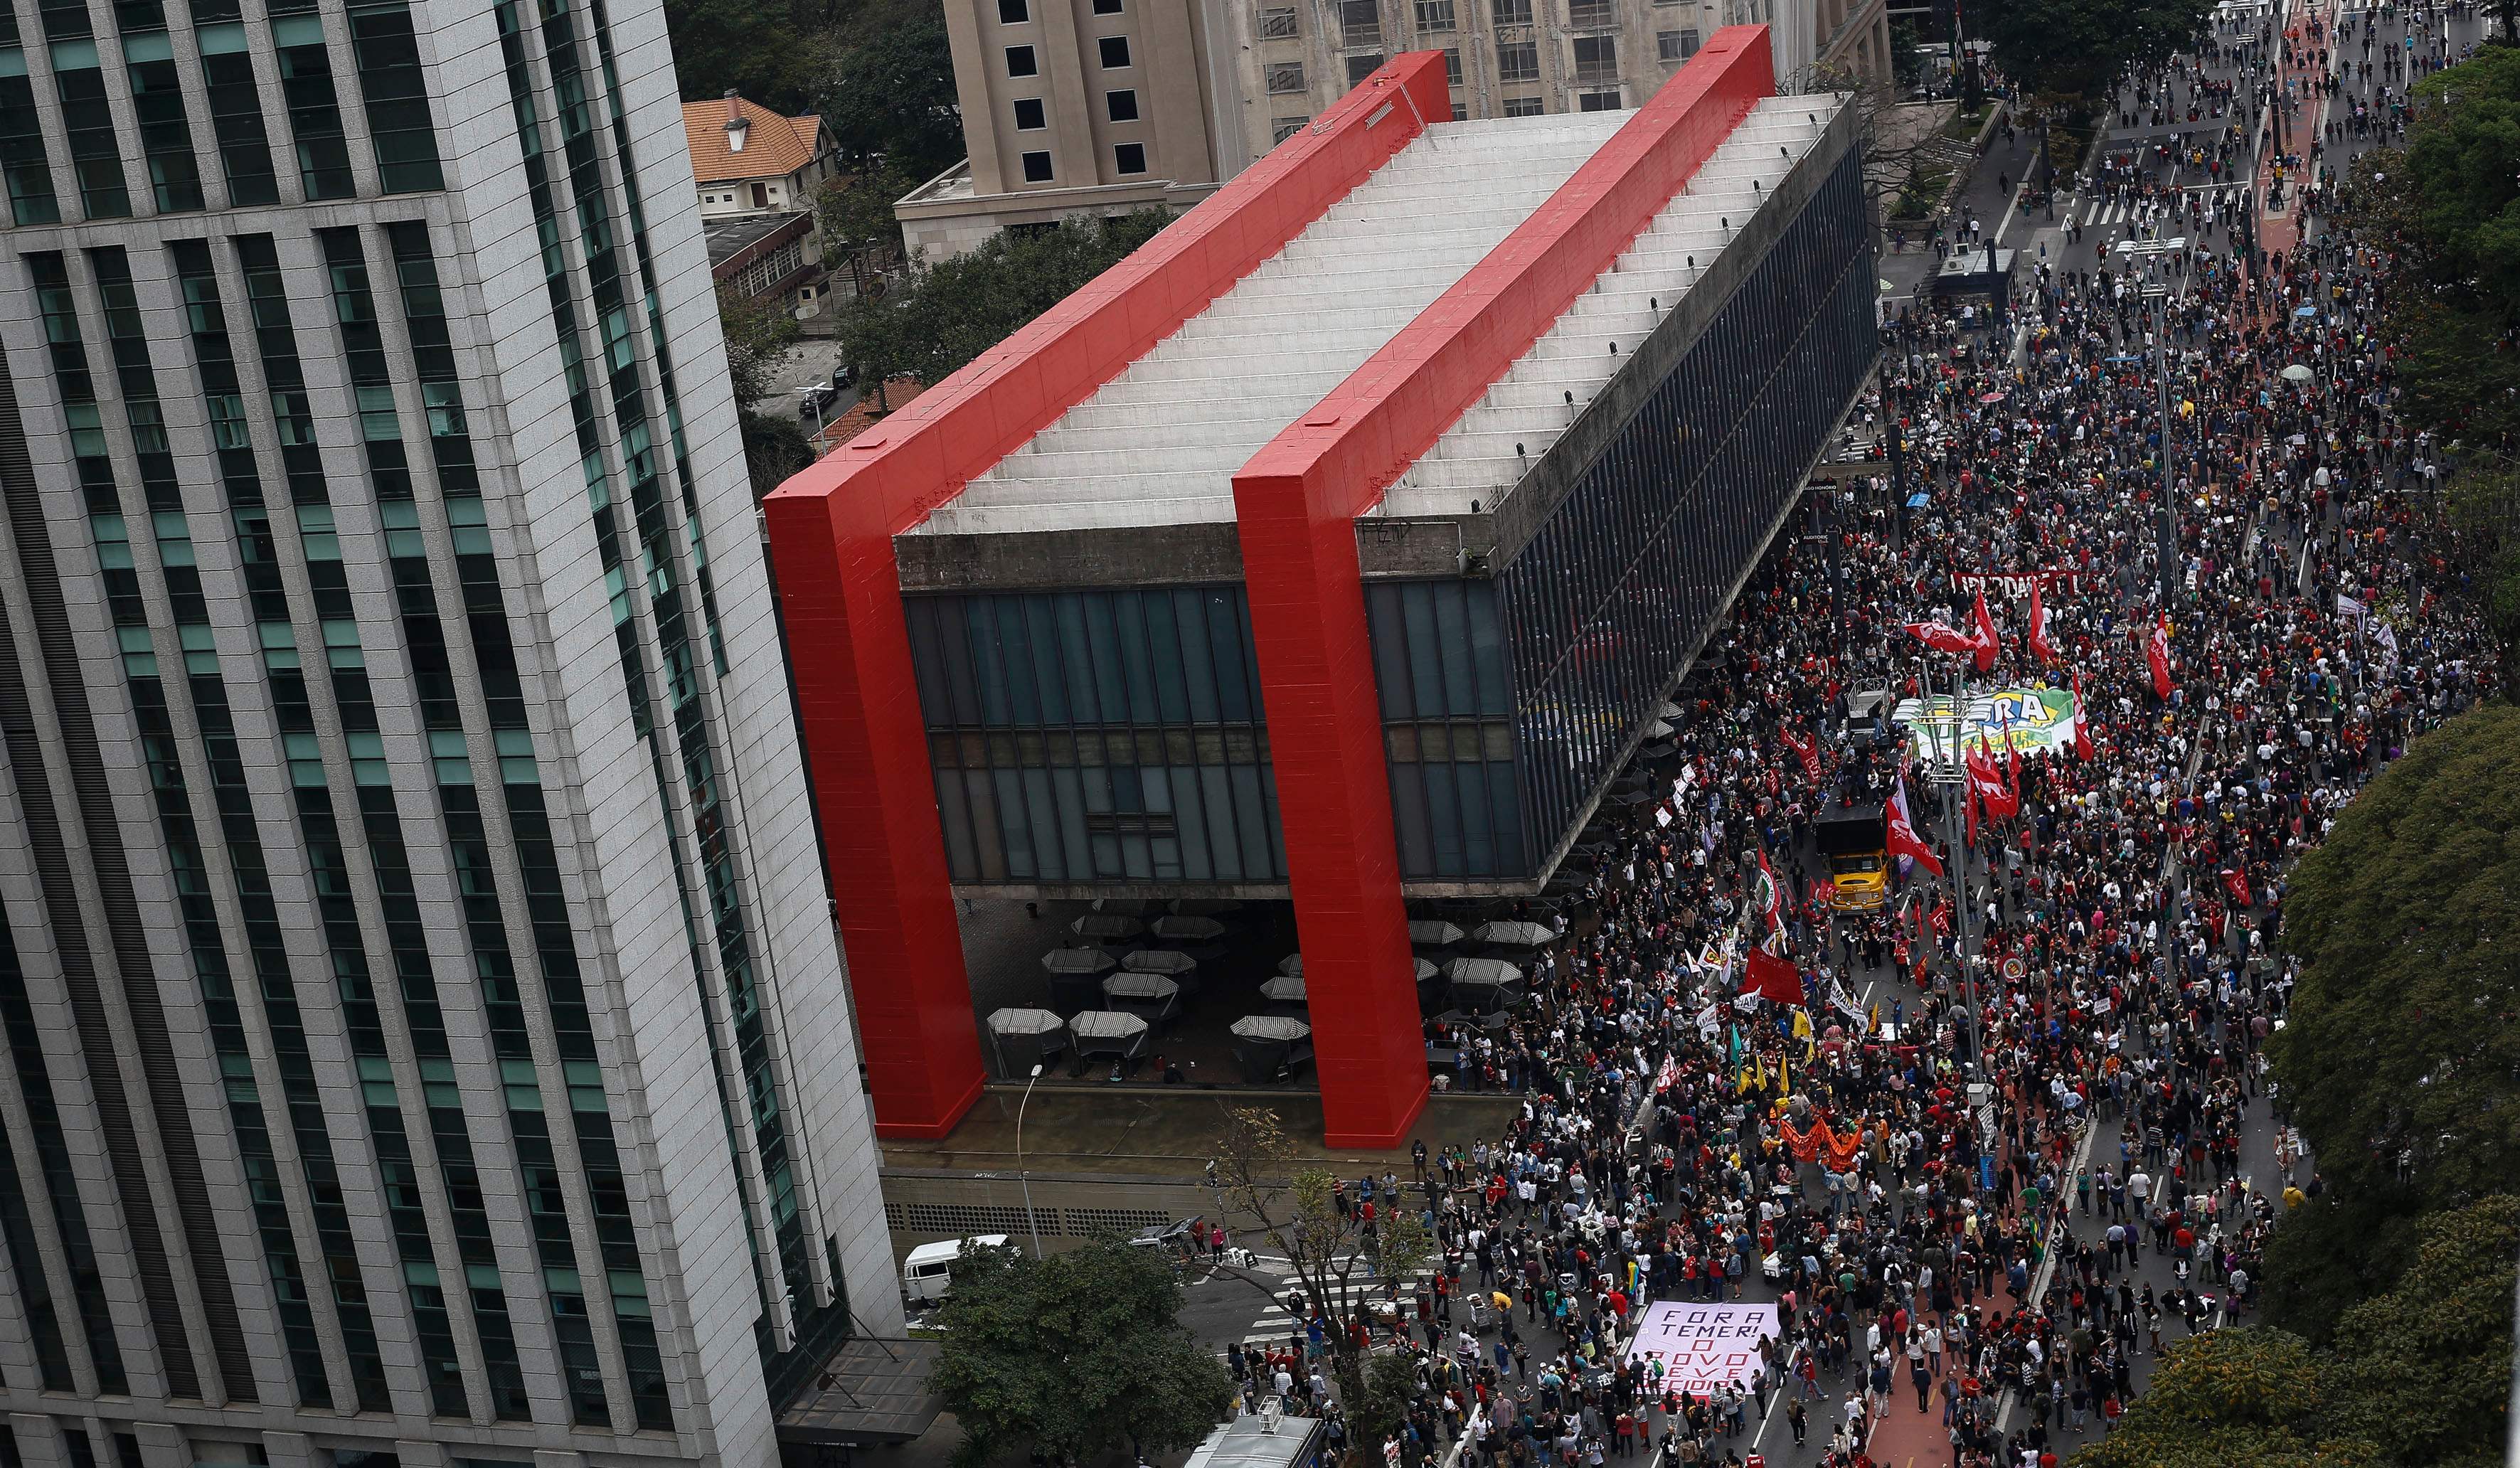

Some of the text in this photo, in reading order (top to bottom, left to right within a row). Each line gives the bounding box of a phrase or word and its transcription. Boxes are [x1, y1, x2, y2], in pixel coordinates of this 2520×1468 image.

[1663, 1310, 1765, 1324] FORA
[1660, 1324, 1760, 1338] TEMER!
[1691, 1339, 1715, 1352] O
[1643, 1367, 1743, 1379] EVE
